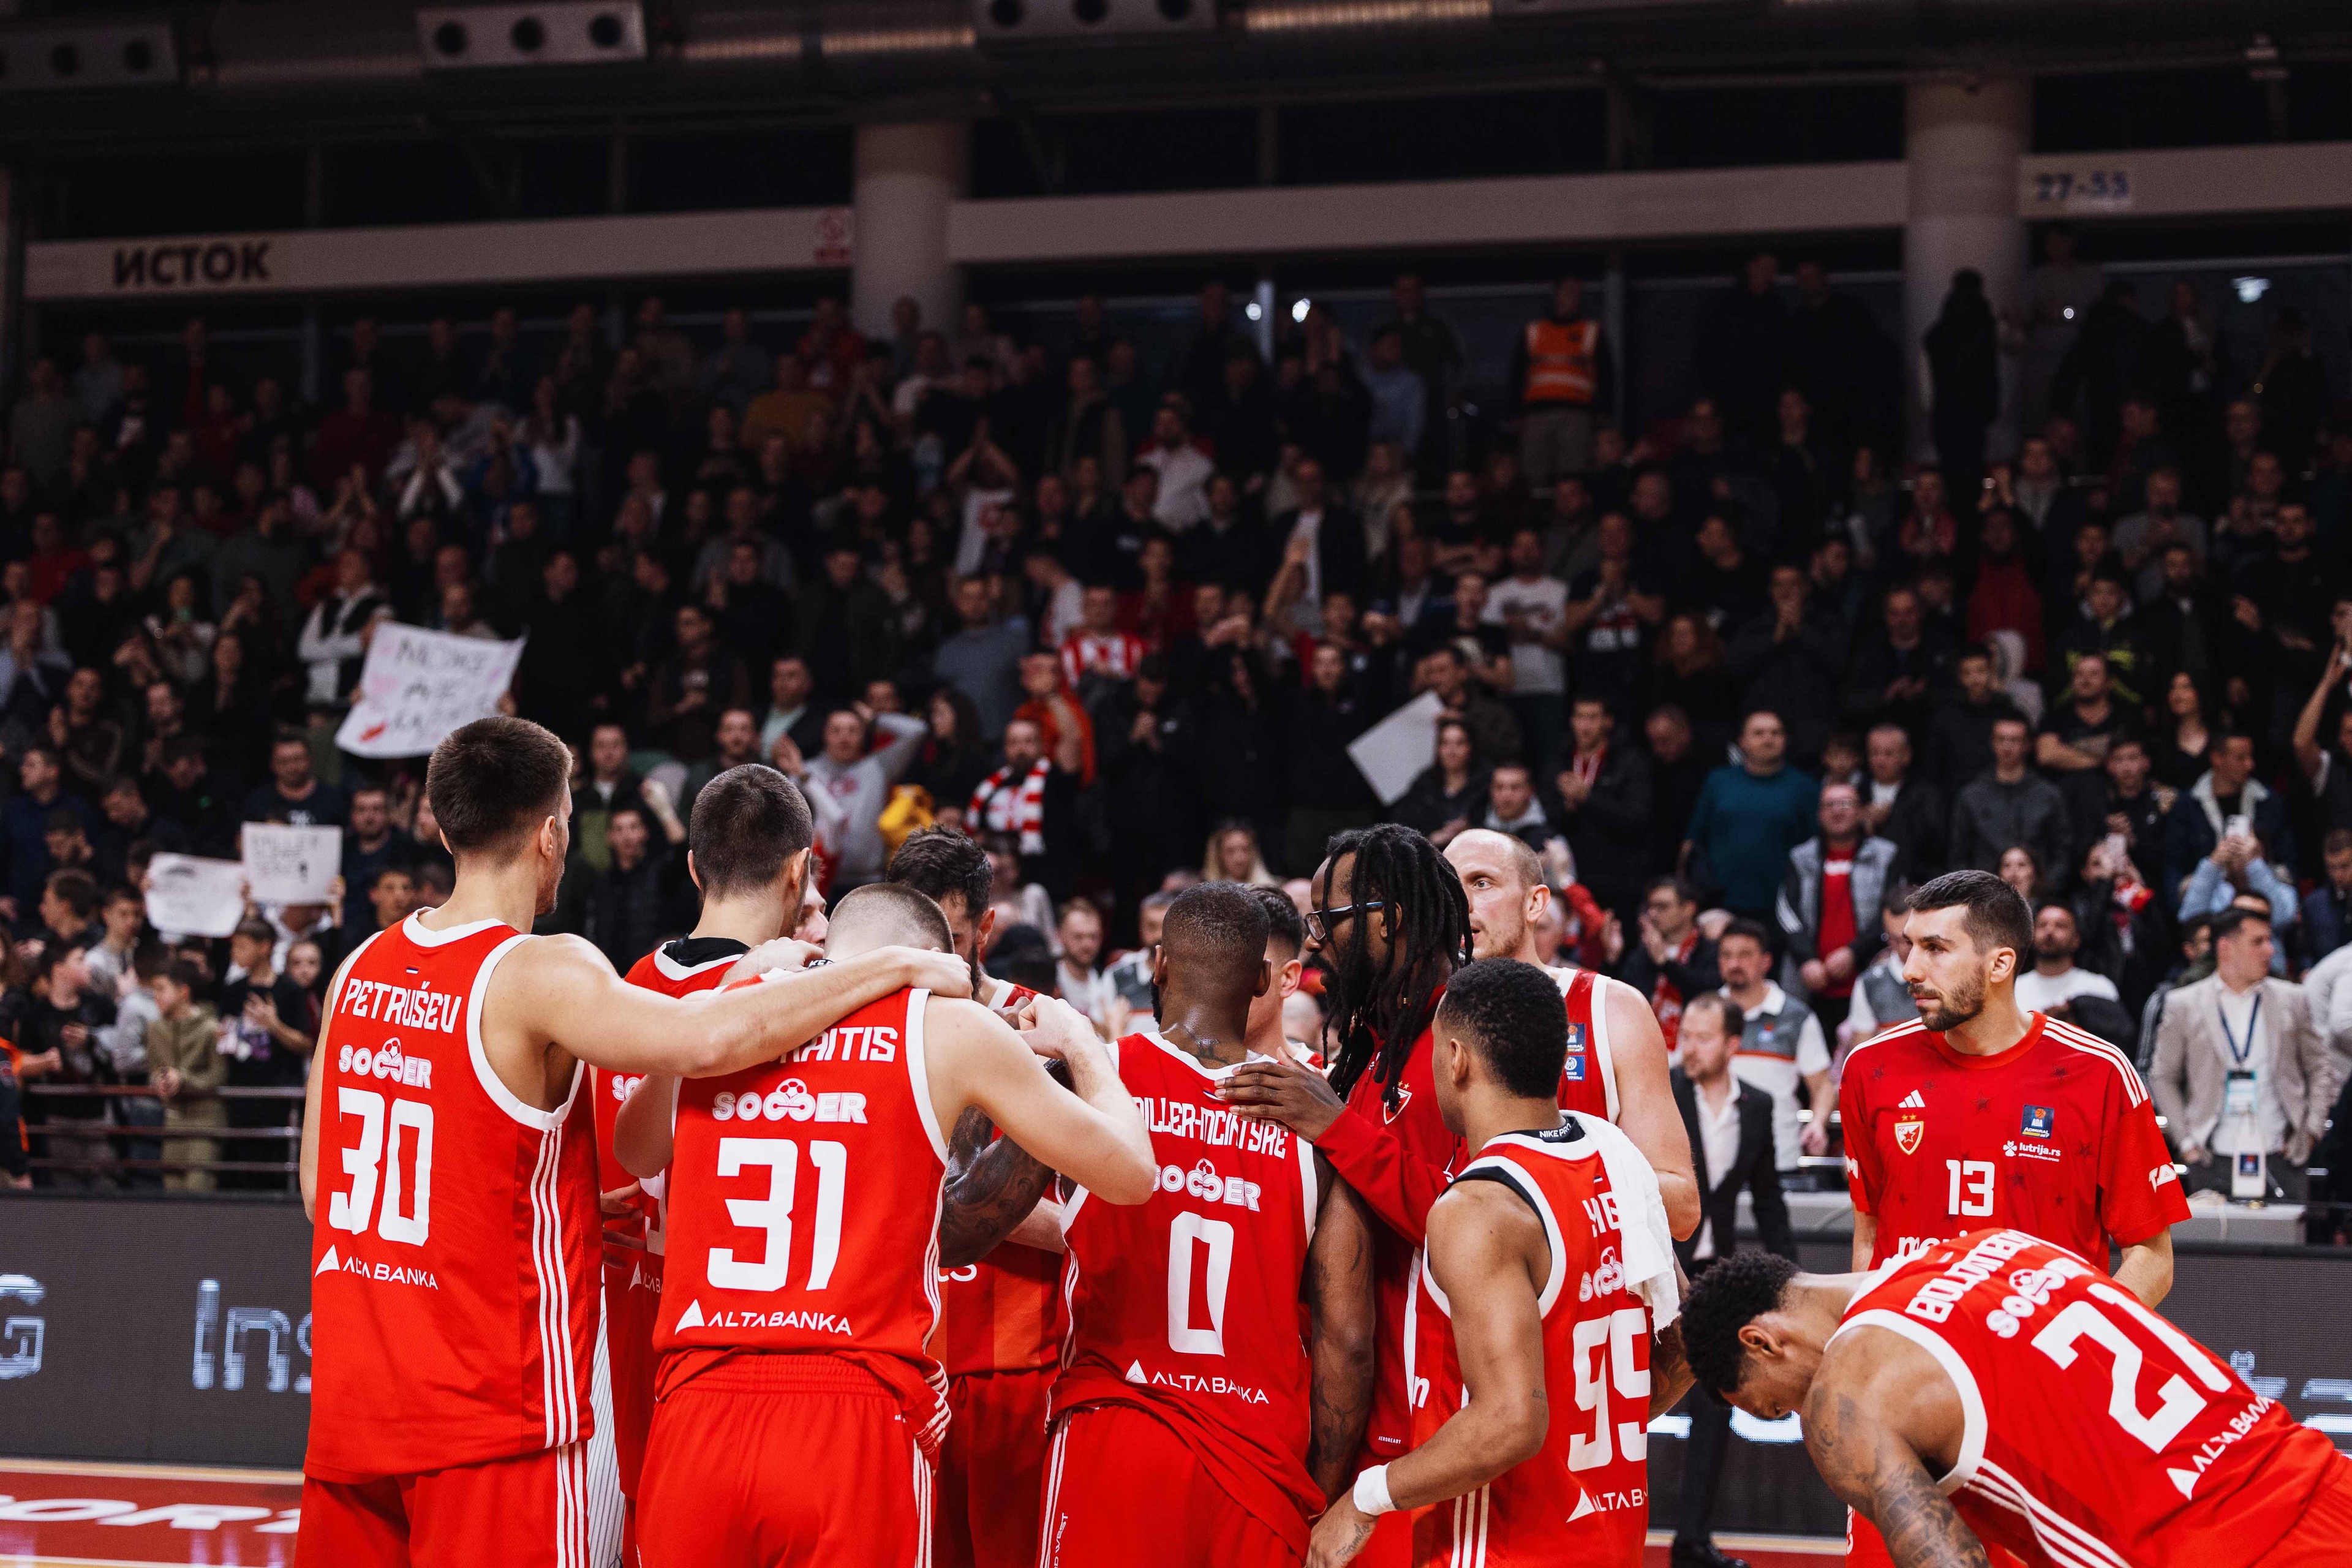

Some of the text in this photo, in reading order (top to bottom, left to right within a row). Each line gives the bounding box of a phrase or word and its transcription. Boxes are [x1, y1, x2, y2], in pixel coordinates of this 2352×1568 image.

[113, 243, 271, 286] ИСТОК
[340, 978, 462, 1033] PETRUŠEV
[339, 1043, 432, 1090] SOCCER
[780, 1027, 898, 1063] AITIS
[712, 1090, 868, 1125] SOCCER
[329, 1086, 434, 1247] 30
[2019, 1142, 2061, 1156] lutrija.rs
[1946, 1159, 1996, 1217] 13
[707, 1137, 847, 1292] 31
[342, 1256, 439, 1291] ALABANKA
[1168, 1210, 1234, 1357] 0
[2031, 1283, 2232, 1454] 21
[1378, 1436, 1401, 1444] AEROREADY
[1055, 1512, 1068, 1553] WEST
